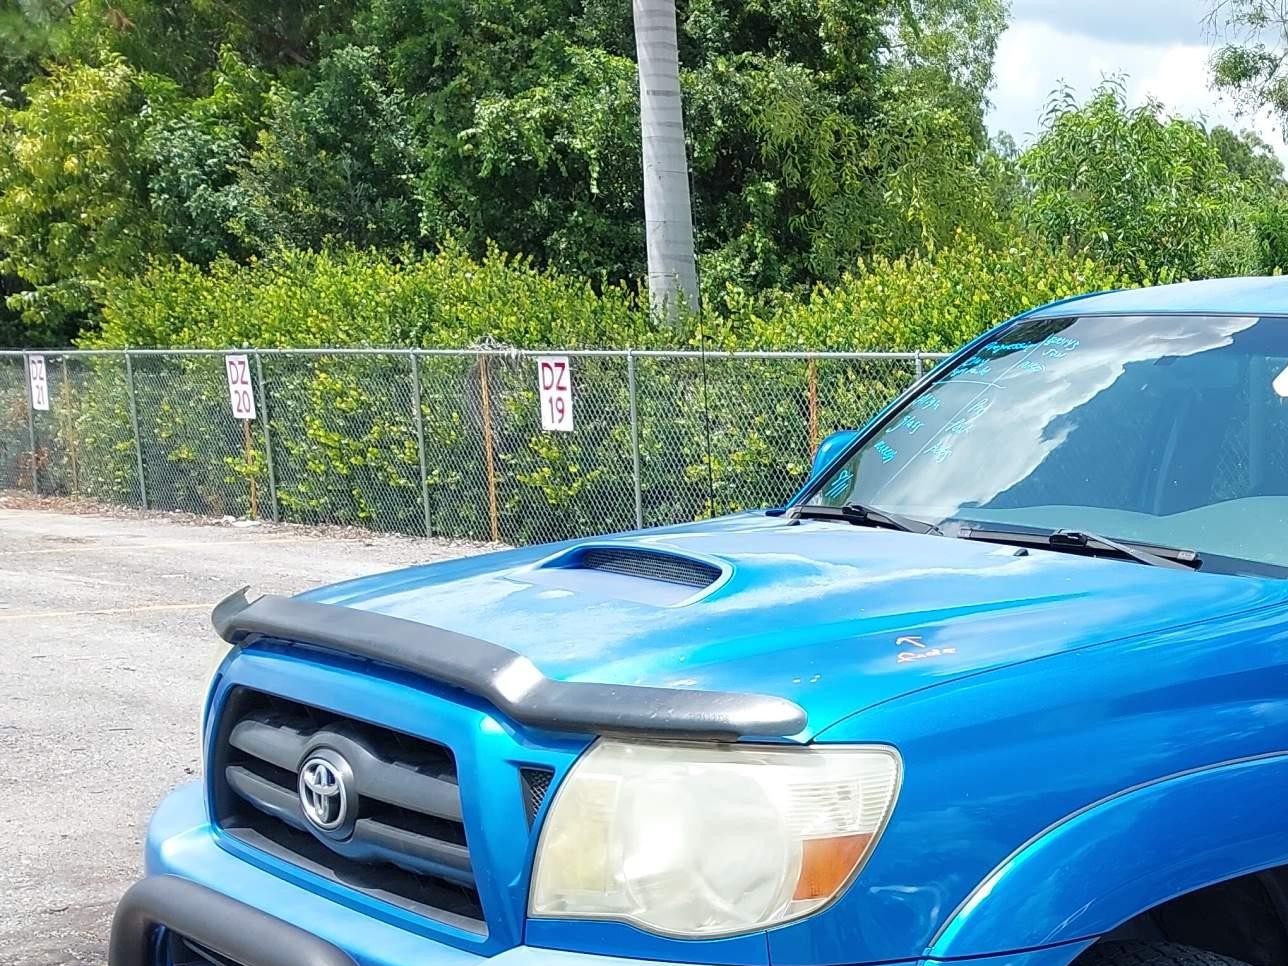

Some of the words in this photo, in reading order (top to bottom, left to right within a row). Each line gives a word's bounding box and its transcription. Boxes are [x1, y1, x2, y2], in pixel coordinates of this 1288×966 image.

[31, 359, 45, 380] DZ
[228, 360, 249, 384] DZ
[541, 362, 567, 391] DZ
[35, 384, 46, 405] 21
[233, 390, 251, 413] 20
[548, 395, 566, 424] 19
